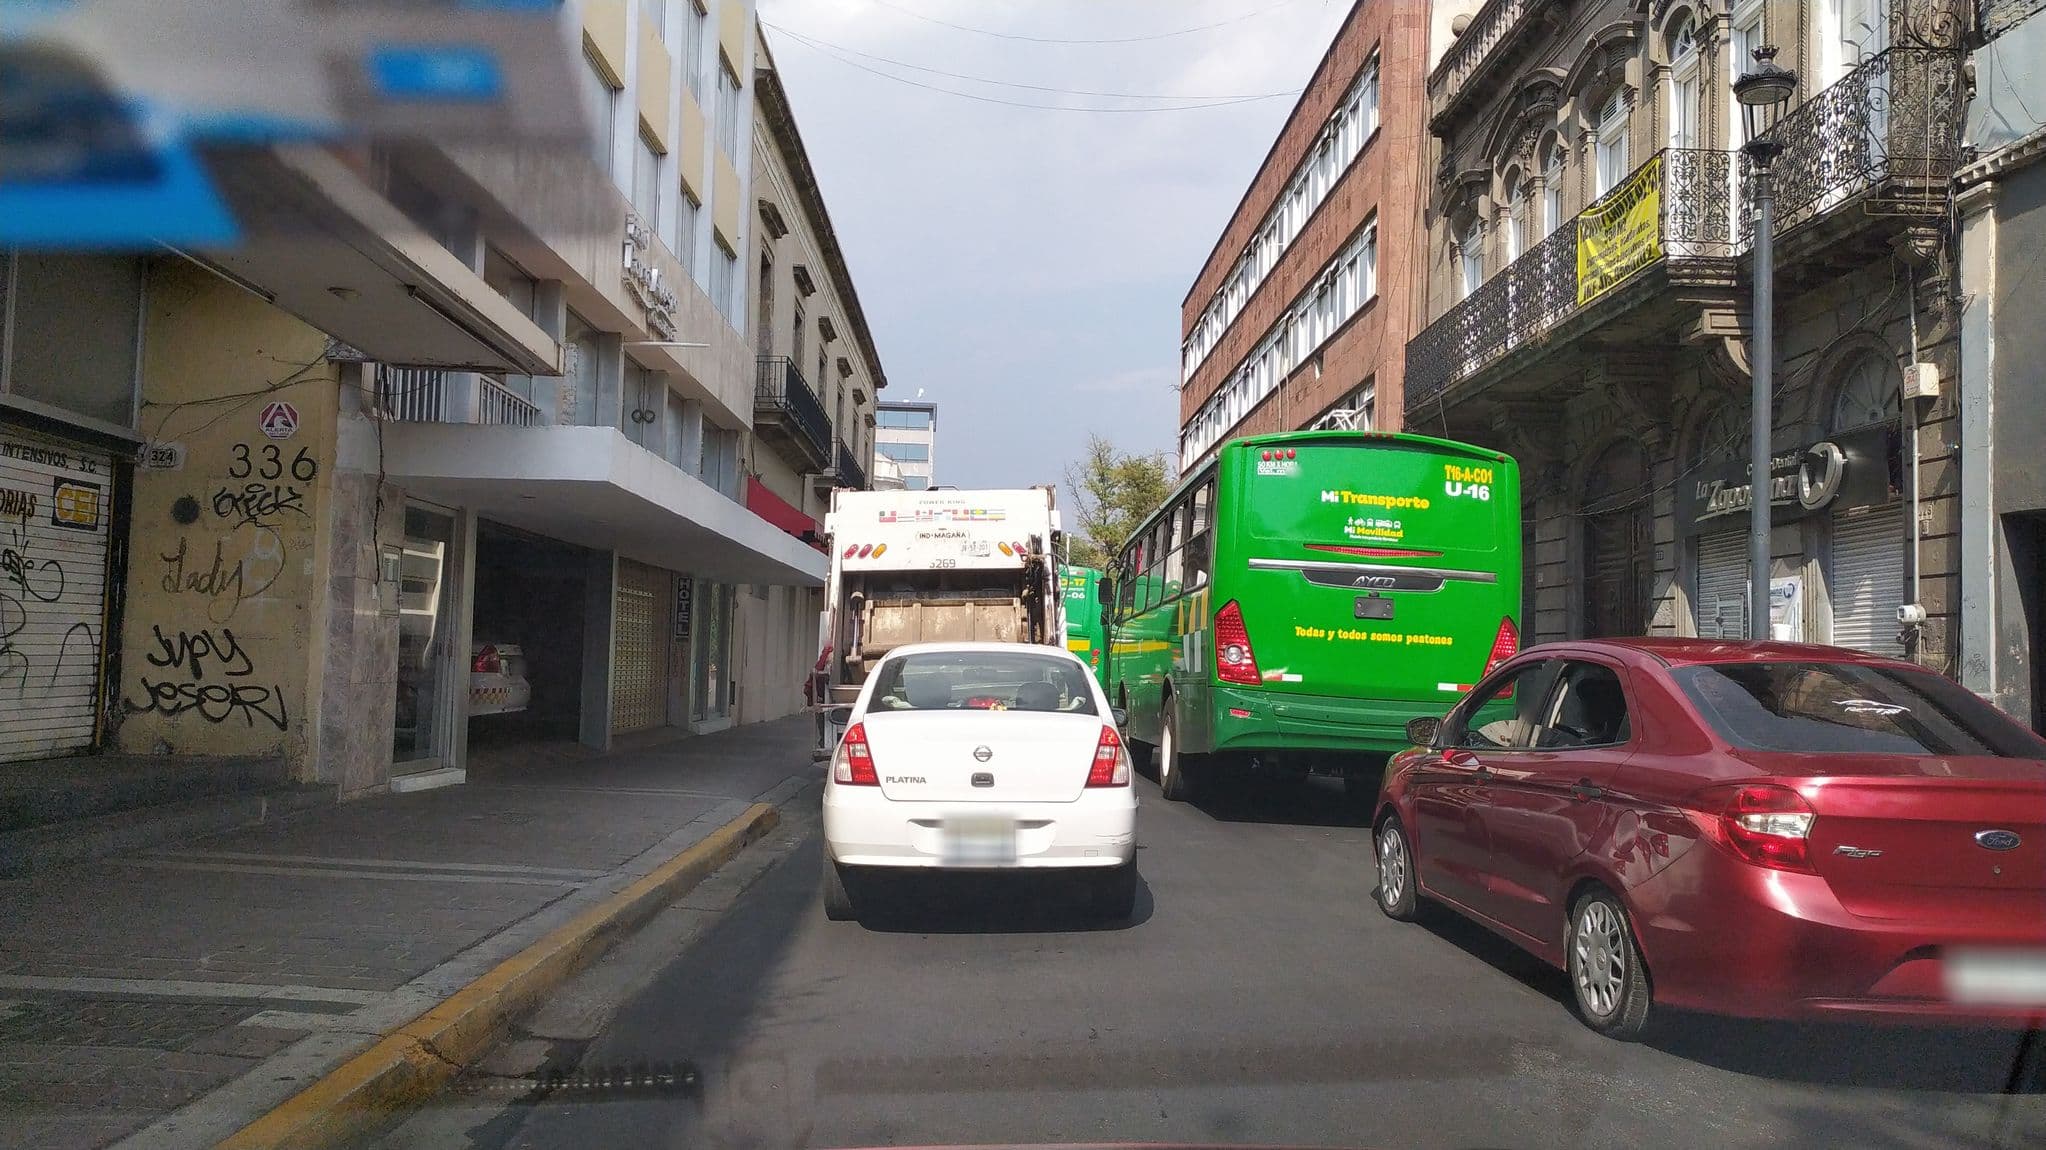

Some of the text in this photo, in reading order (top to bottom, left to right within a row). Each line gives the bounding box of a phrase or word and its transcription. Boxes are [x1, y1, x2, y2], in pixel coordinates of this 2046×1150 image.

[229, 443, 317, 481] 336
[1321, 490, 1339, 503] Mi
[1445, 481, 1490, 501] U-16
[1344, 526, 1404, 537] Mi Movilidad
[678, 578, 690, 635] HOTEL
[1294, 625, 1326, 638] Todas
[1327, 630, 1335, 641] y
[1337, 629, 1368, 640] todos
[1370, 632, 1403, 642] somos
[885, 775, 928, 785] PLATINA
